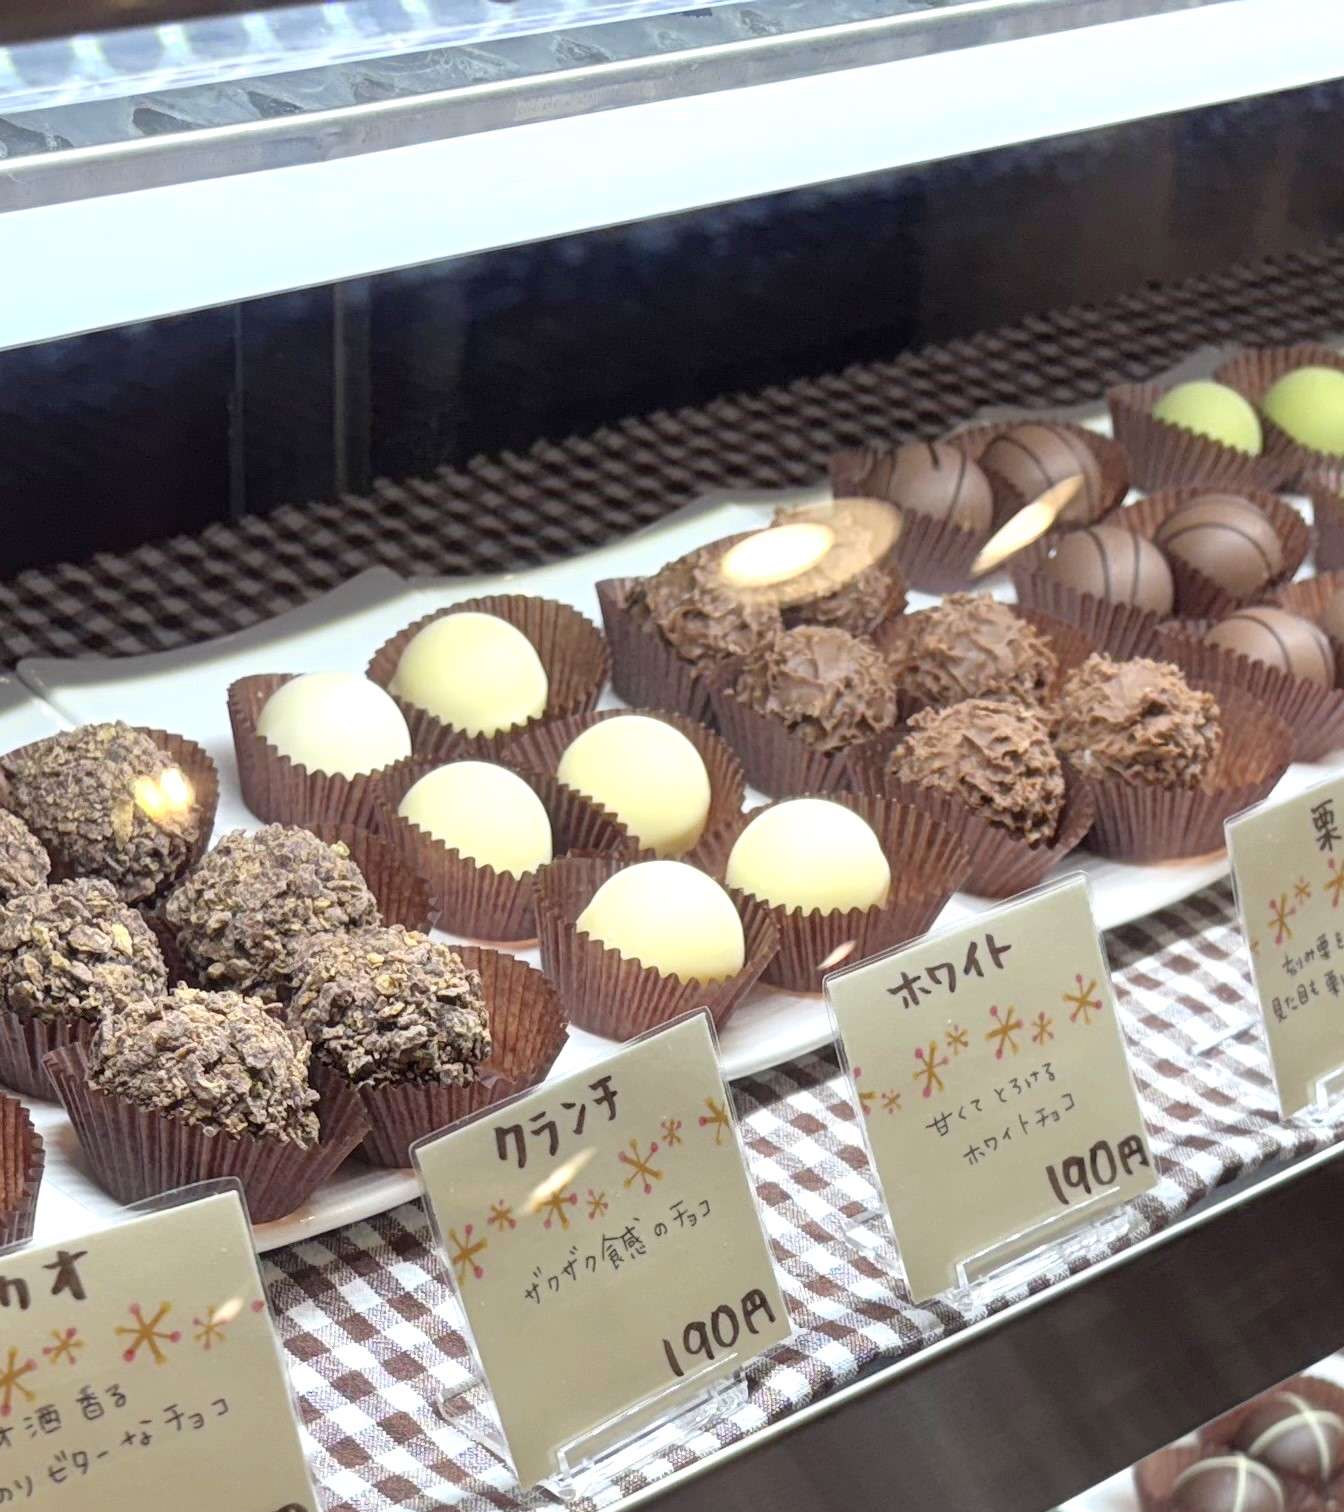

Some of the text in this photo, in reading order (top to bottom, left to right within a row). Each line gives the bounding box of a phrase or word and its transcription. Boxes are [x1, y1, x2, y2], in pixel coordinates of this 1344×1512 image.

[1310, 798, 1342, 853] 栗
[886, 933, 1012, 1009] ホワイト
[494, 1074, 619, 1169] クランチ
[925, 1062, 1057, 1137] 甘くてとろける
[962, 1092, 1076, 1166] ホワイトチョコ
[1045, 1134, 1152, 1205] 190円
[524, 1198, 712, 1305] ザクザク食感のチョコ
[660, 1288, 777, 1377] 190円
